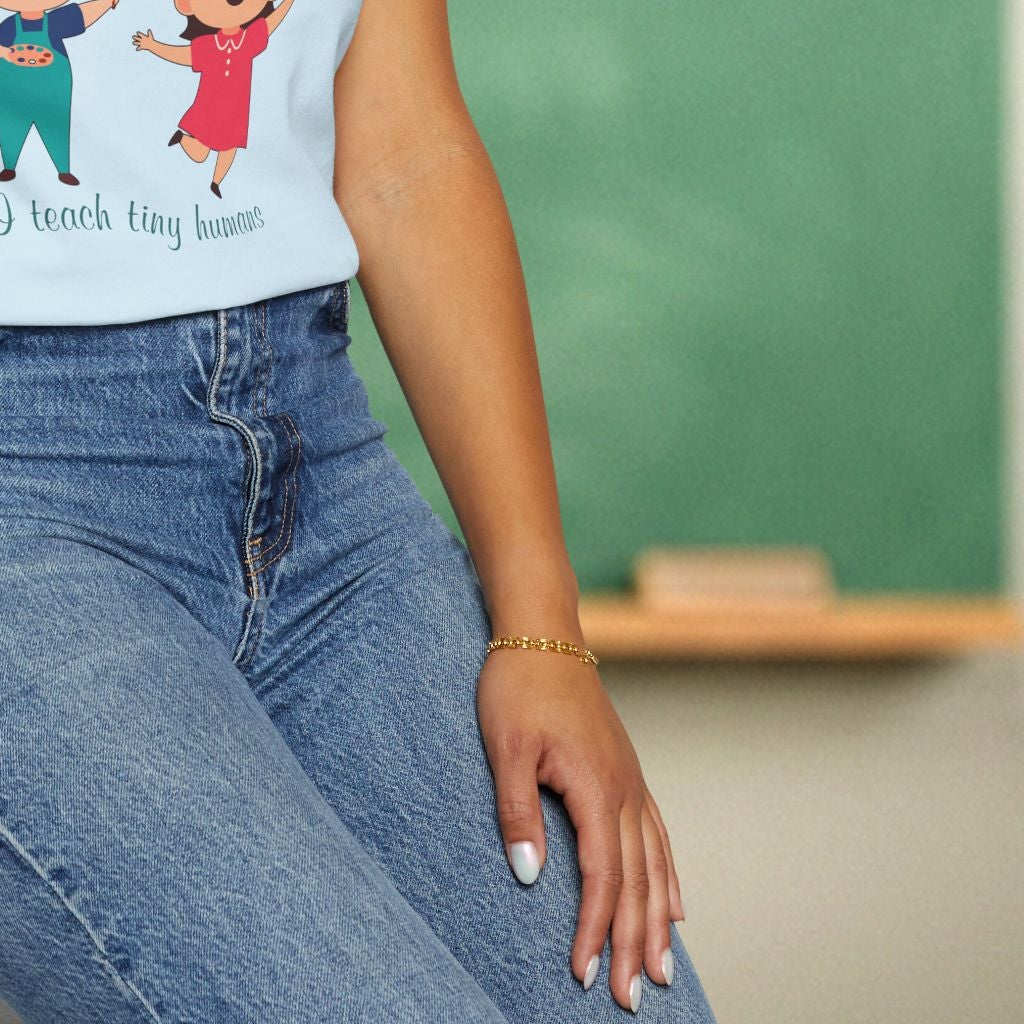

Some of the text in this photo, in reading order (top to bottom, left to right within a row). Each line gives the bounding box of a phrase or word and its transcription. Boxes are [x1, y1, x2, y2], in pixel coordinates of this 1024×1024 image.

[31, 193, 113, 232] teach
[128, 201, 182, 251] tiny
[195, 204, 265, 241] humans
